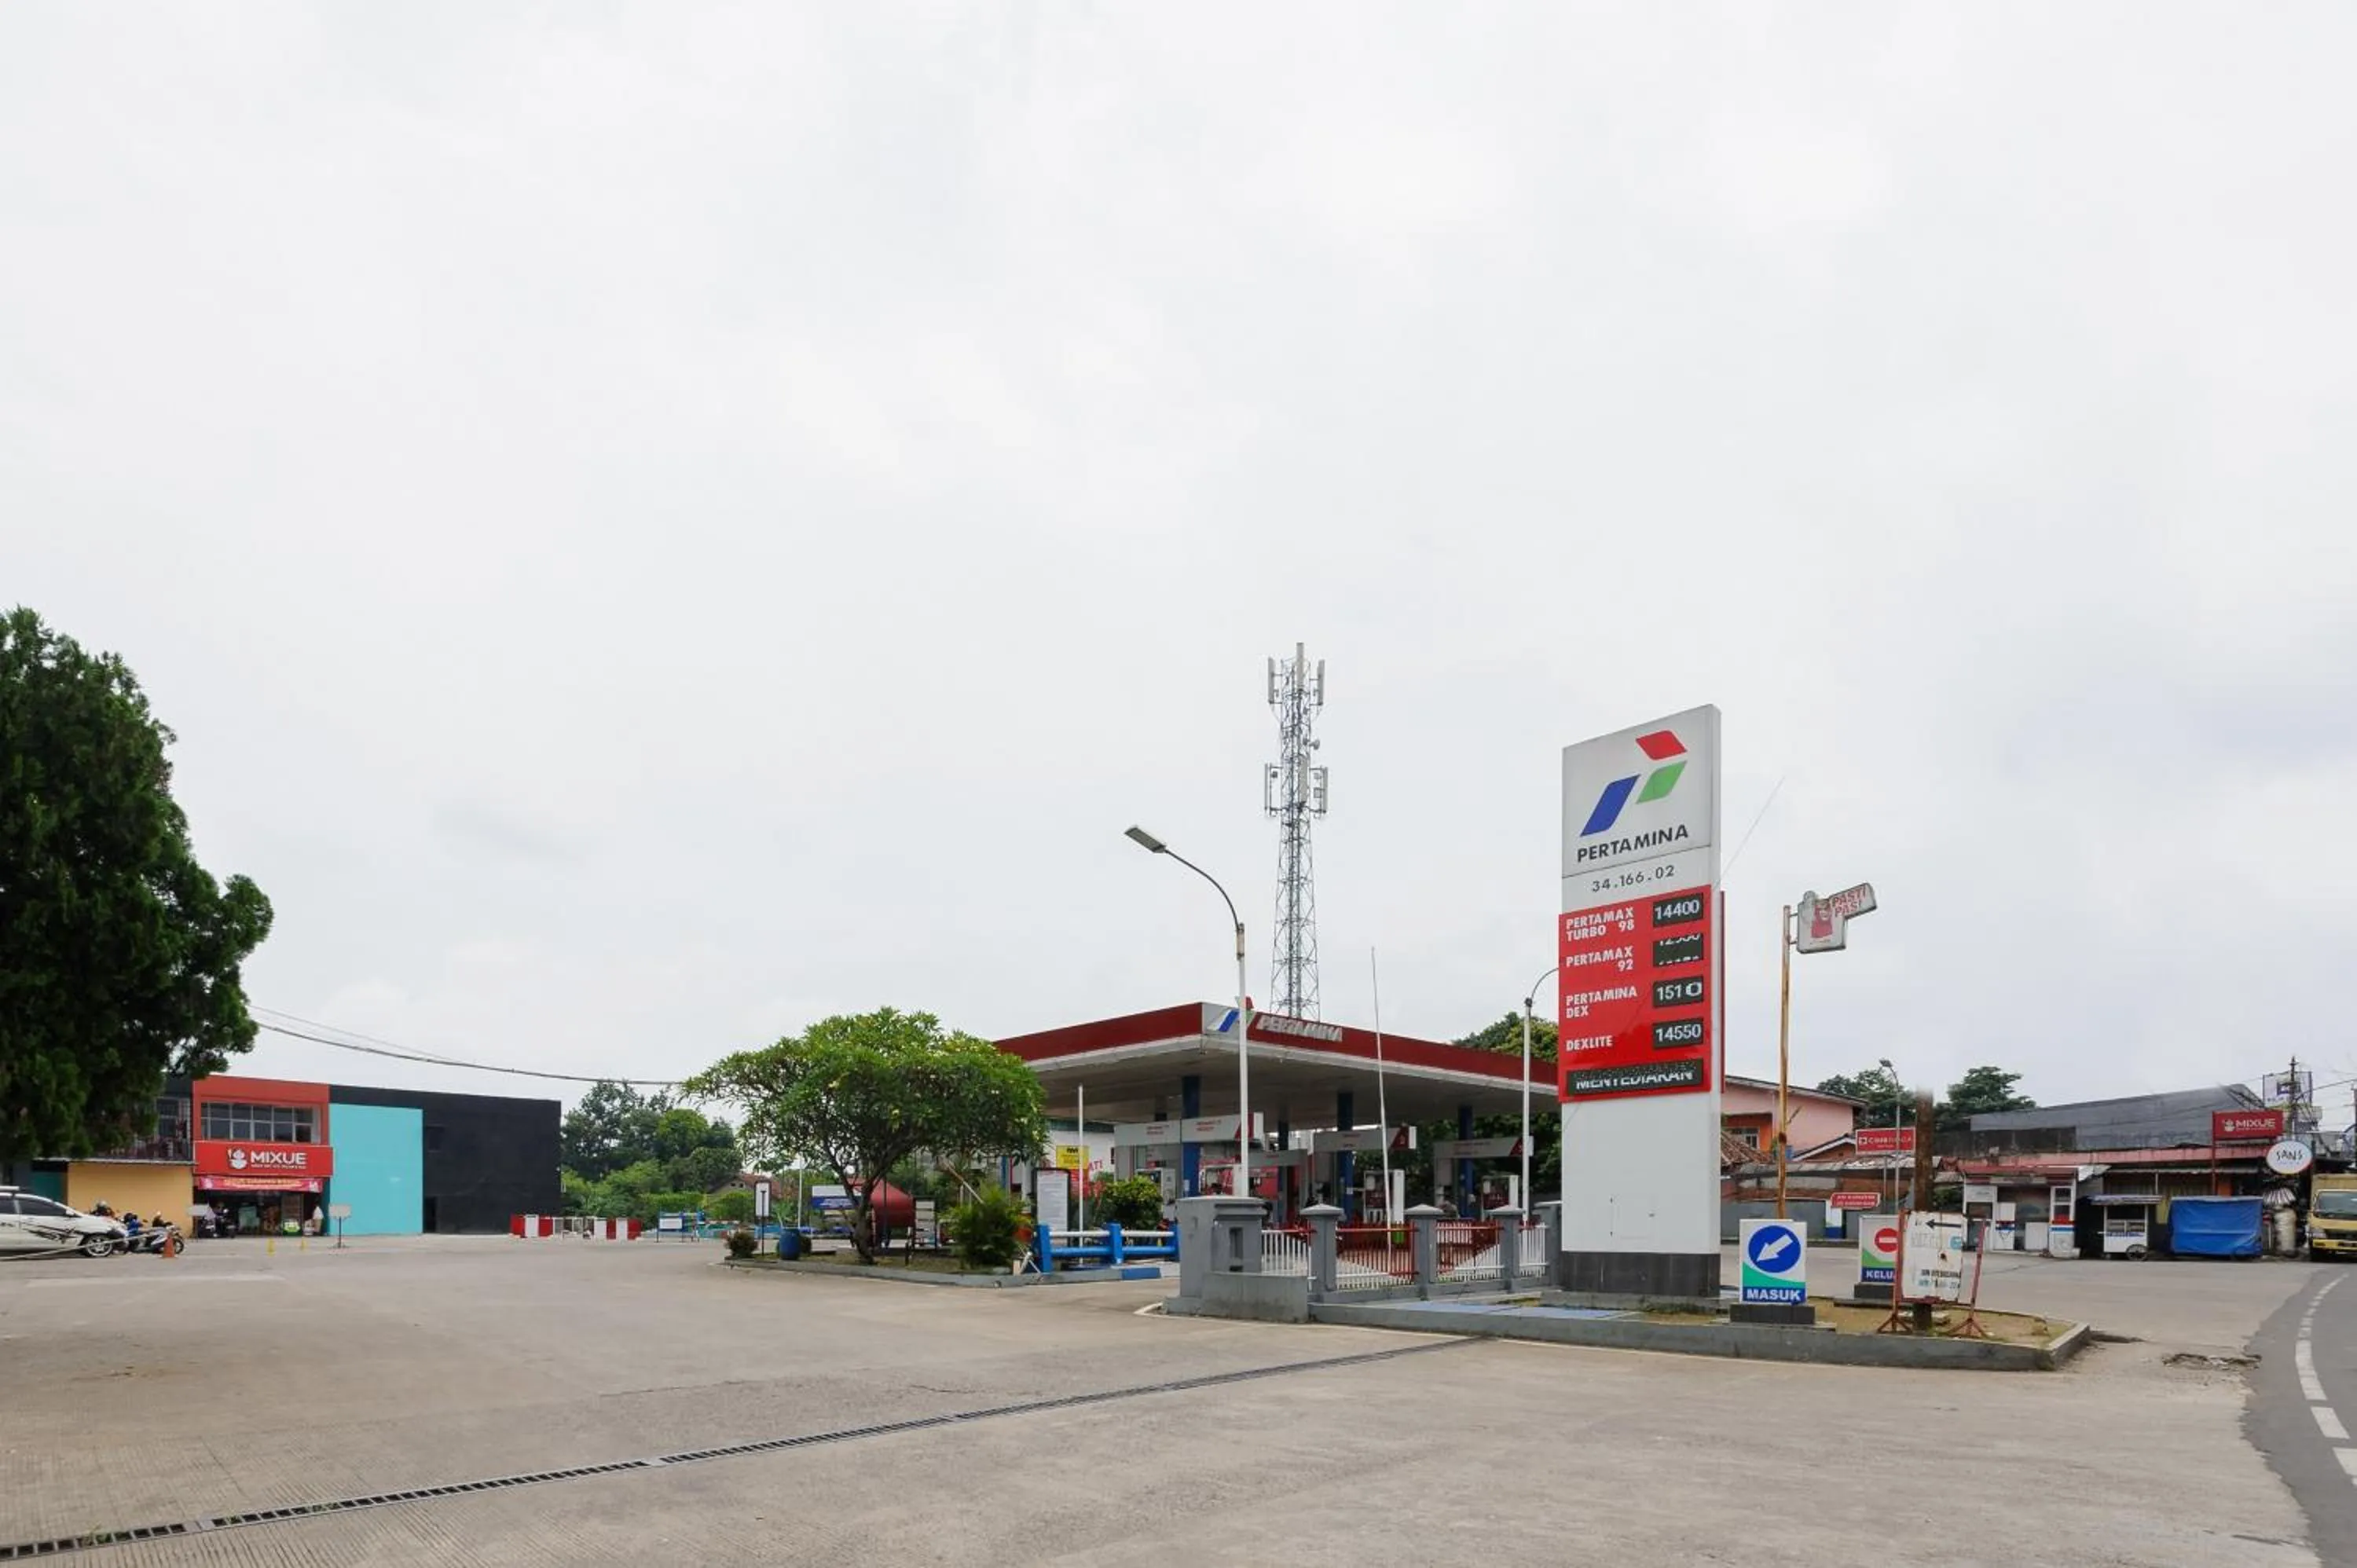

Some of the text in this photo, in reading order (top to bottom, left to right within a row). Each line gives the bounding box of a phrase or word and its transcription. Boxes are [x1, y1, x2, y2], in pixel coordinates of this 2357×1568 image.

[1577, 824, 1688, 863] PERTAMINA
[1592, 865, 1675, 892] 34.166.02
[1566, 907, 1634, 930] PERTAMAX
[1654, 899, 1699, 920] 14400
[1566, 919, 1635, 942] TURBO 98
[1566, 946, 1633, 968] PERTAMAX
[1617, 959, 1633, 972] 92
[1566, 986, 1637, 1006] PERTAMINA
[1566, 1005, 1589, 1019] DEX
[1655, 1024, 1701, 1042] 14550
[1566, 1035, 1613, 1051] DEXLITE
[2235, 1119, 2276, 1128] MIXUE
[250, 1150, 308, 1165] MIXUE
[1866, 1269, 1896, 1280] KELU
[1747, 1288, 1802, 1302] MASUK
